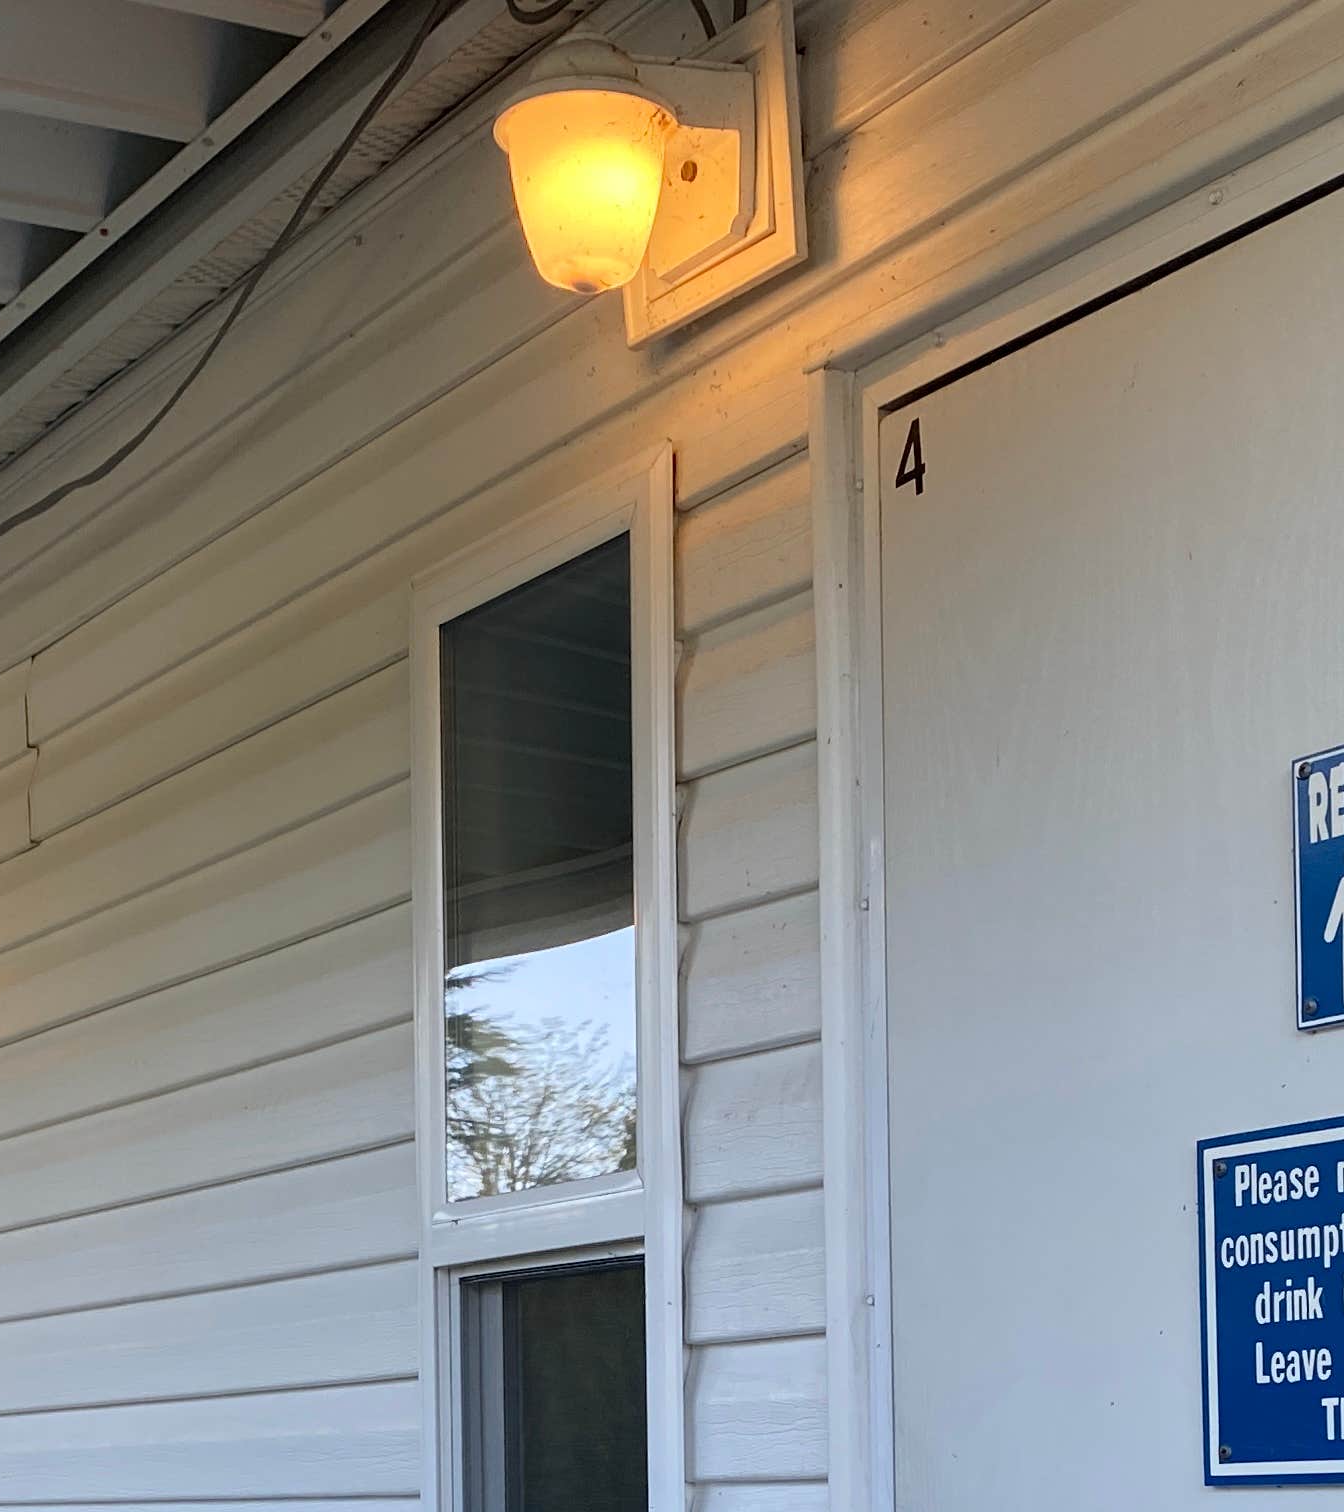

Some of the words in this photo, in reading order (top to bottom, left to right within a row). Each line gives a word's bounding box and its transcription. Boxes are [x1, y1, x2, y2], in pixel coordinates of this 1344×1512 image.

[895, 416, 926, 496] 4
[1234, 1162, 1320, 1207] Please
[1255, 1276, 1324, 1325] drink
[1255, 1341, 1332, 1384] Leave
